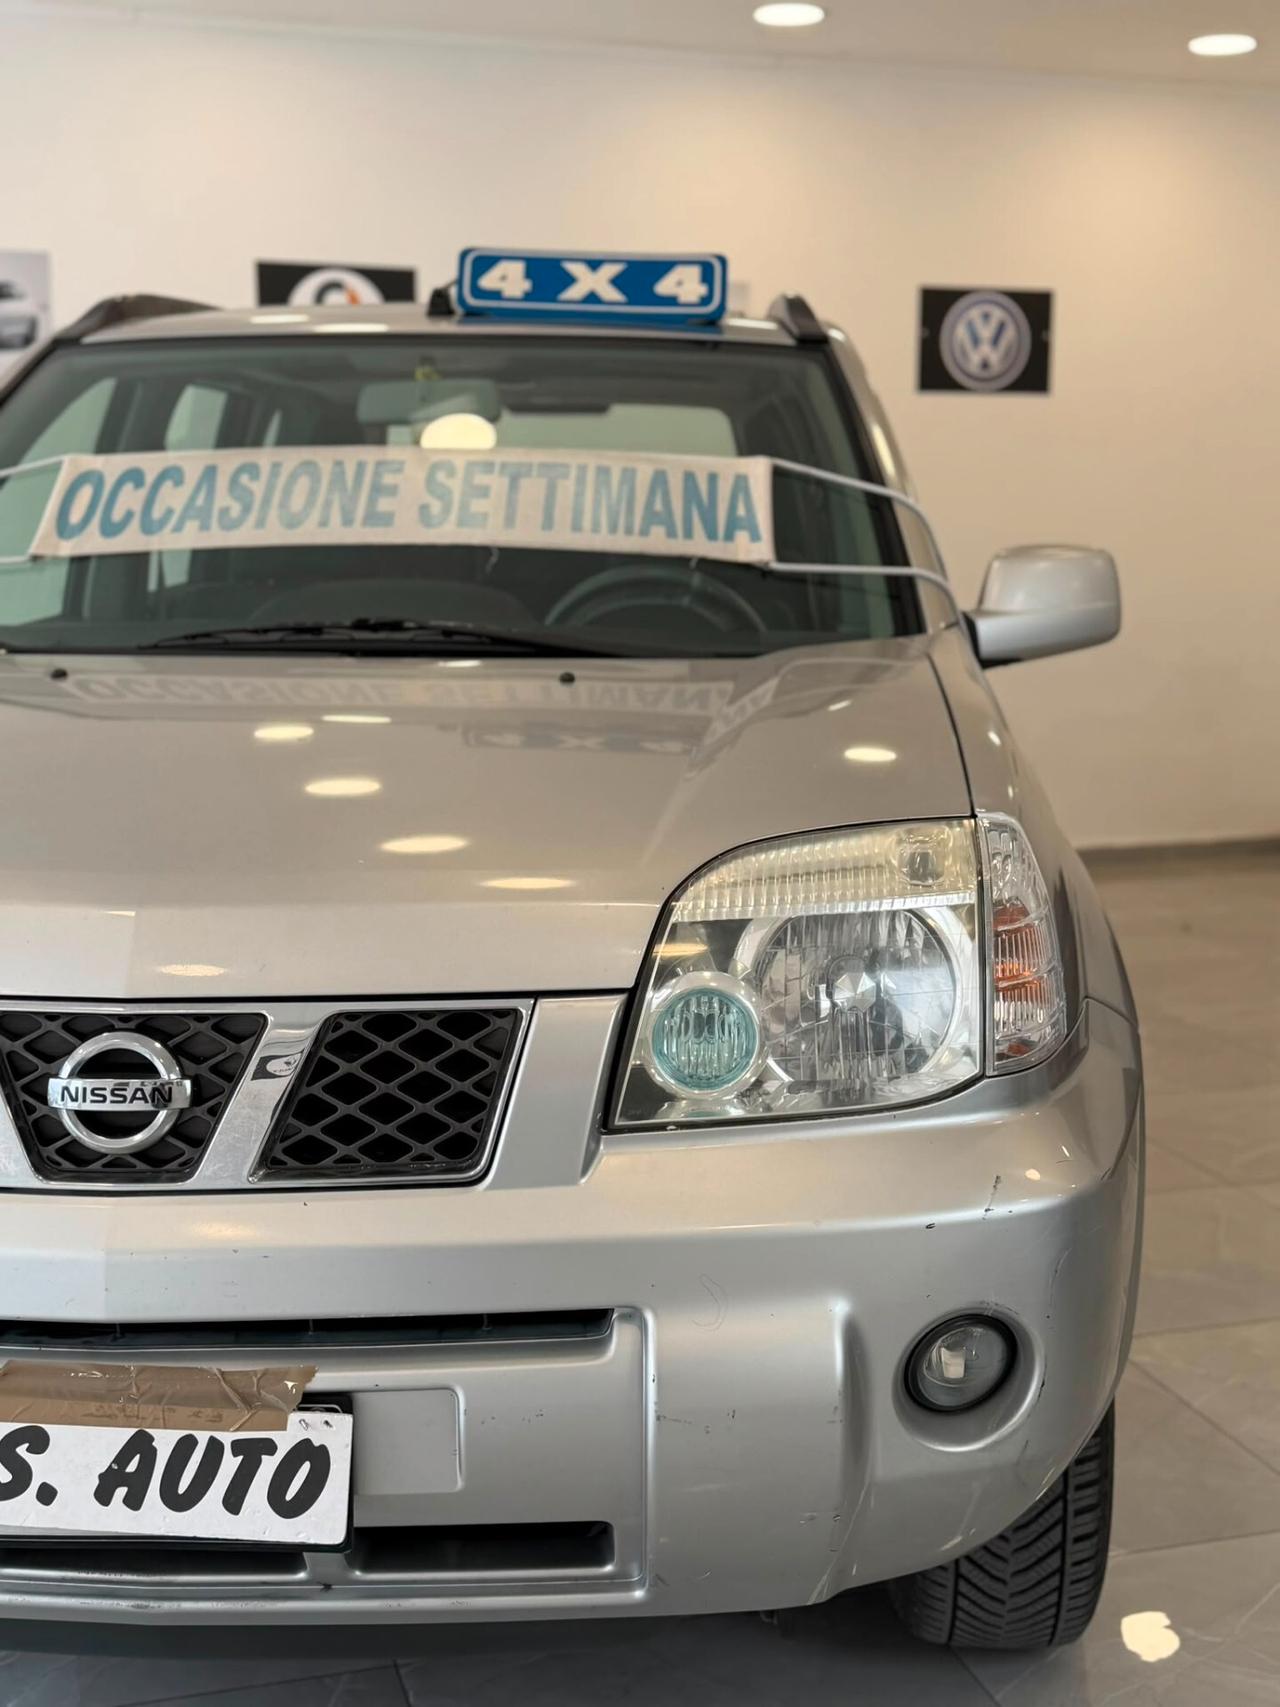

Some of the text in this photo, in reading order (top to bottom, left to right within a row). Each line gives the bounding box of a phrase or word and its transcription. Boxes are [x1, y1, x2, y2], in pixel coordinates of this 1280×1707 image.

[477, 259, 709, 305] 4 X 4
[55, 459, 762, 544] OCCASIONE SETTIMANA
[60, 1085, 173, 1104] NISSAN
[93, 1428, 331, 1519] AUTO
